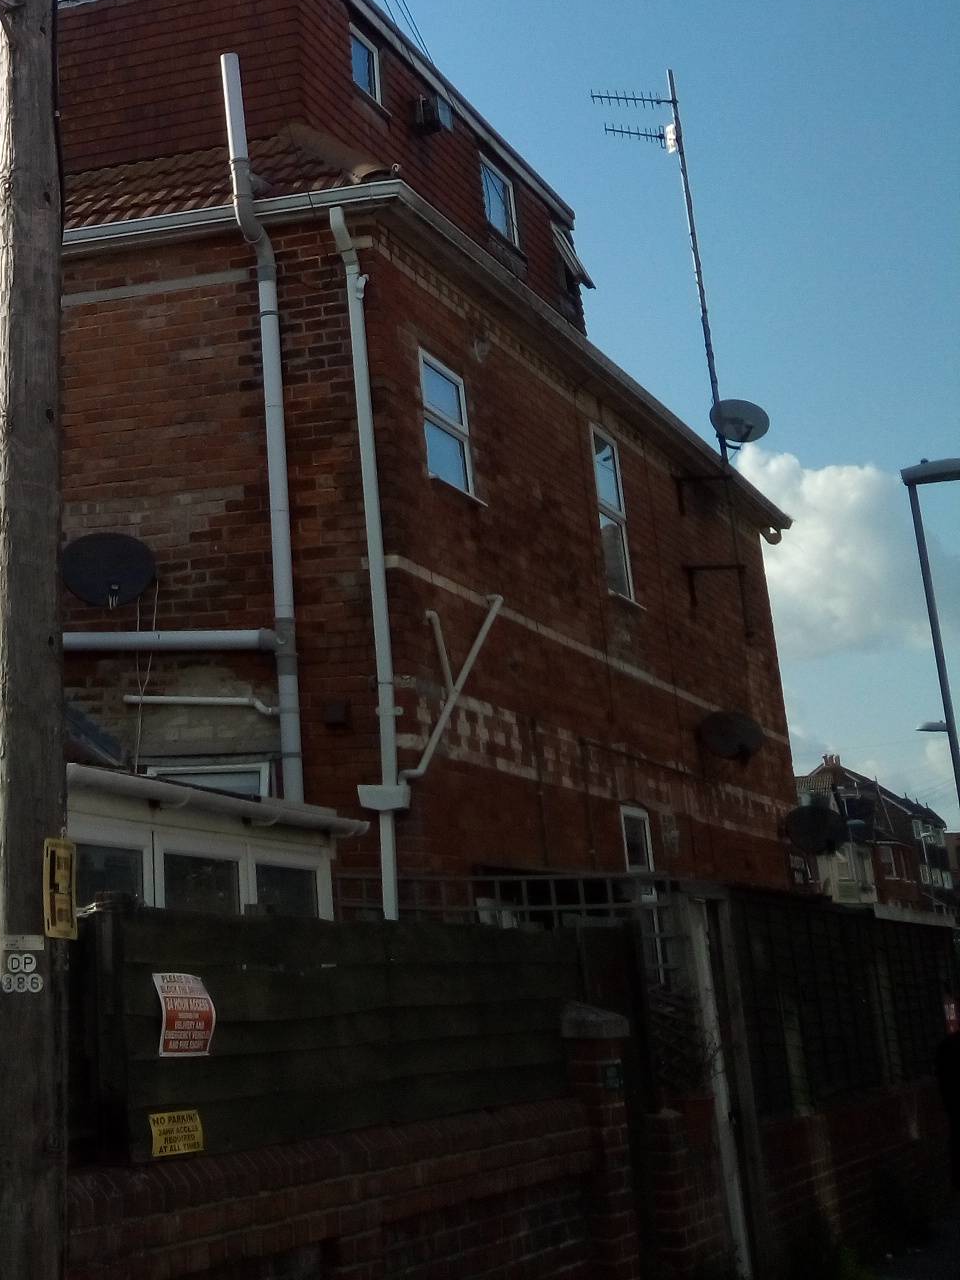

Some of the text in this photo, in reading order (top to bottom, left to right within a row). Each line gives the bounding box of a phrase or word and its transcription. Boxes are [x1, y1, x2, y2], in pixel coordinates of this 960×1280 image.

[11, 956, 33, 970] DP
[189, 999, 209, 1011] ACCESS
[152, 1116, 166, 1126] NO
[159, 1145, 168, 1153] AT
[169, 1144, 180, 1152] ALL
